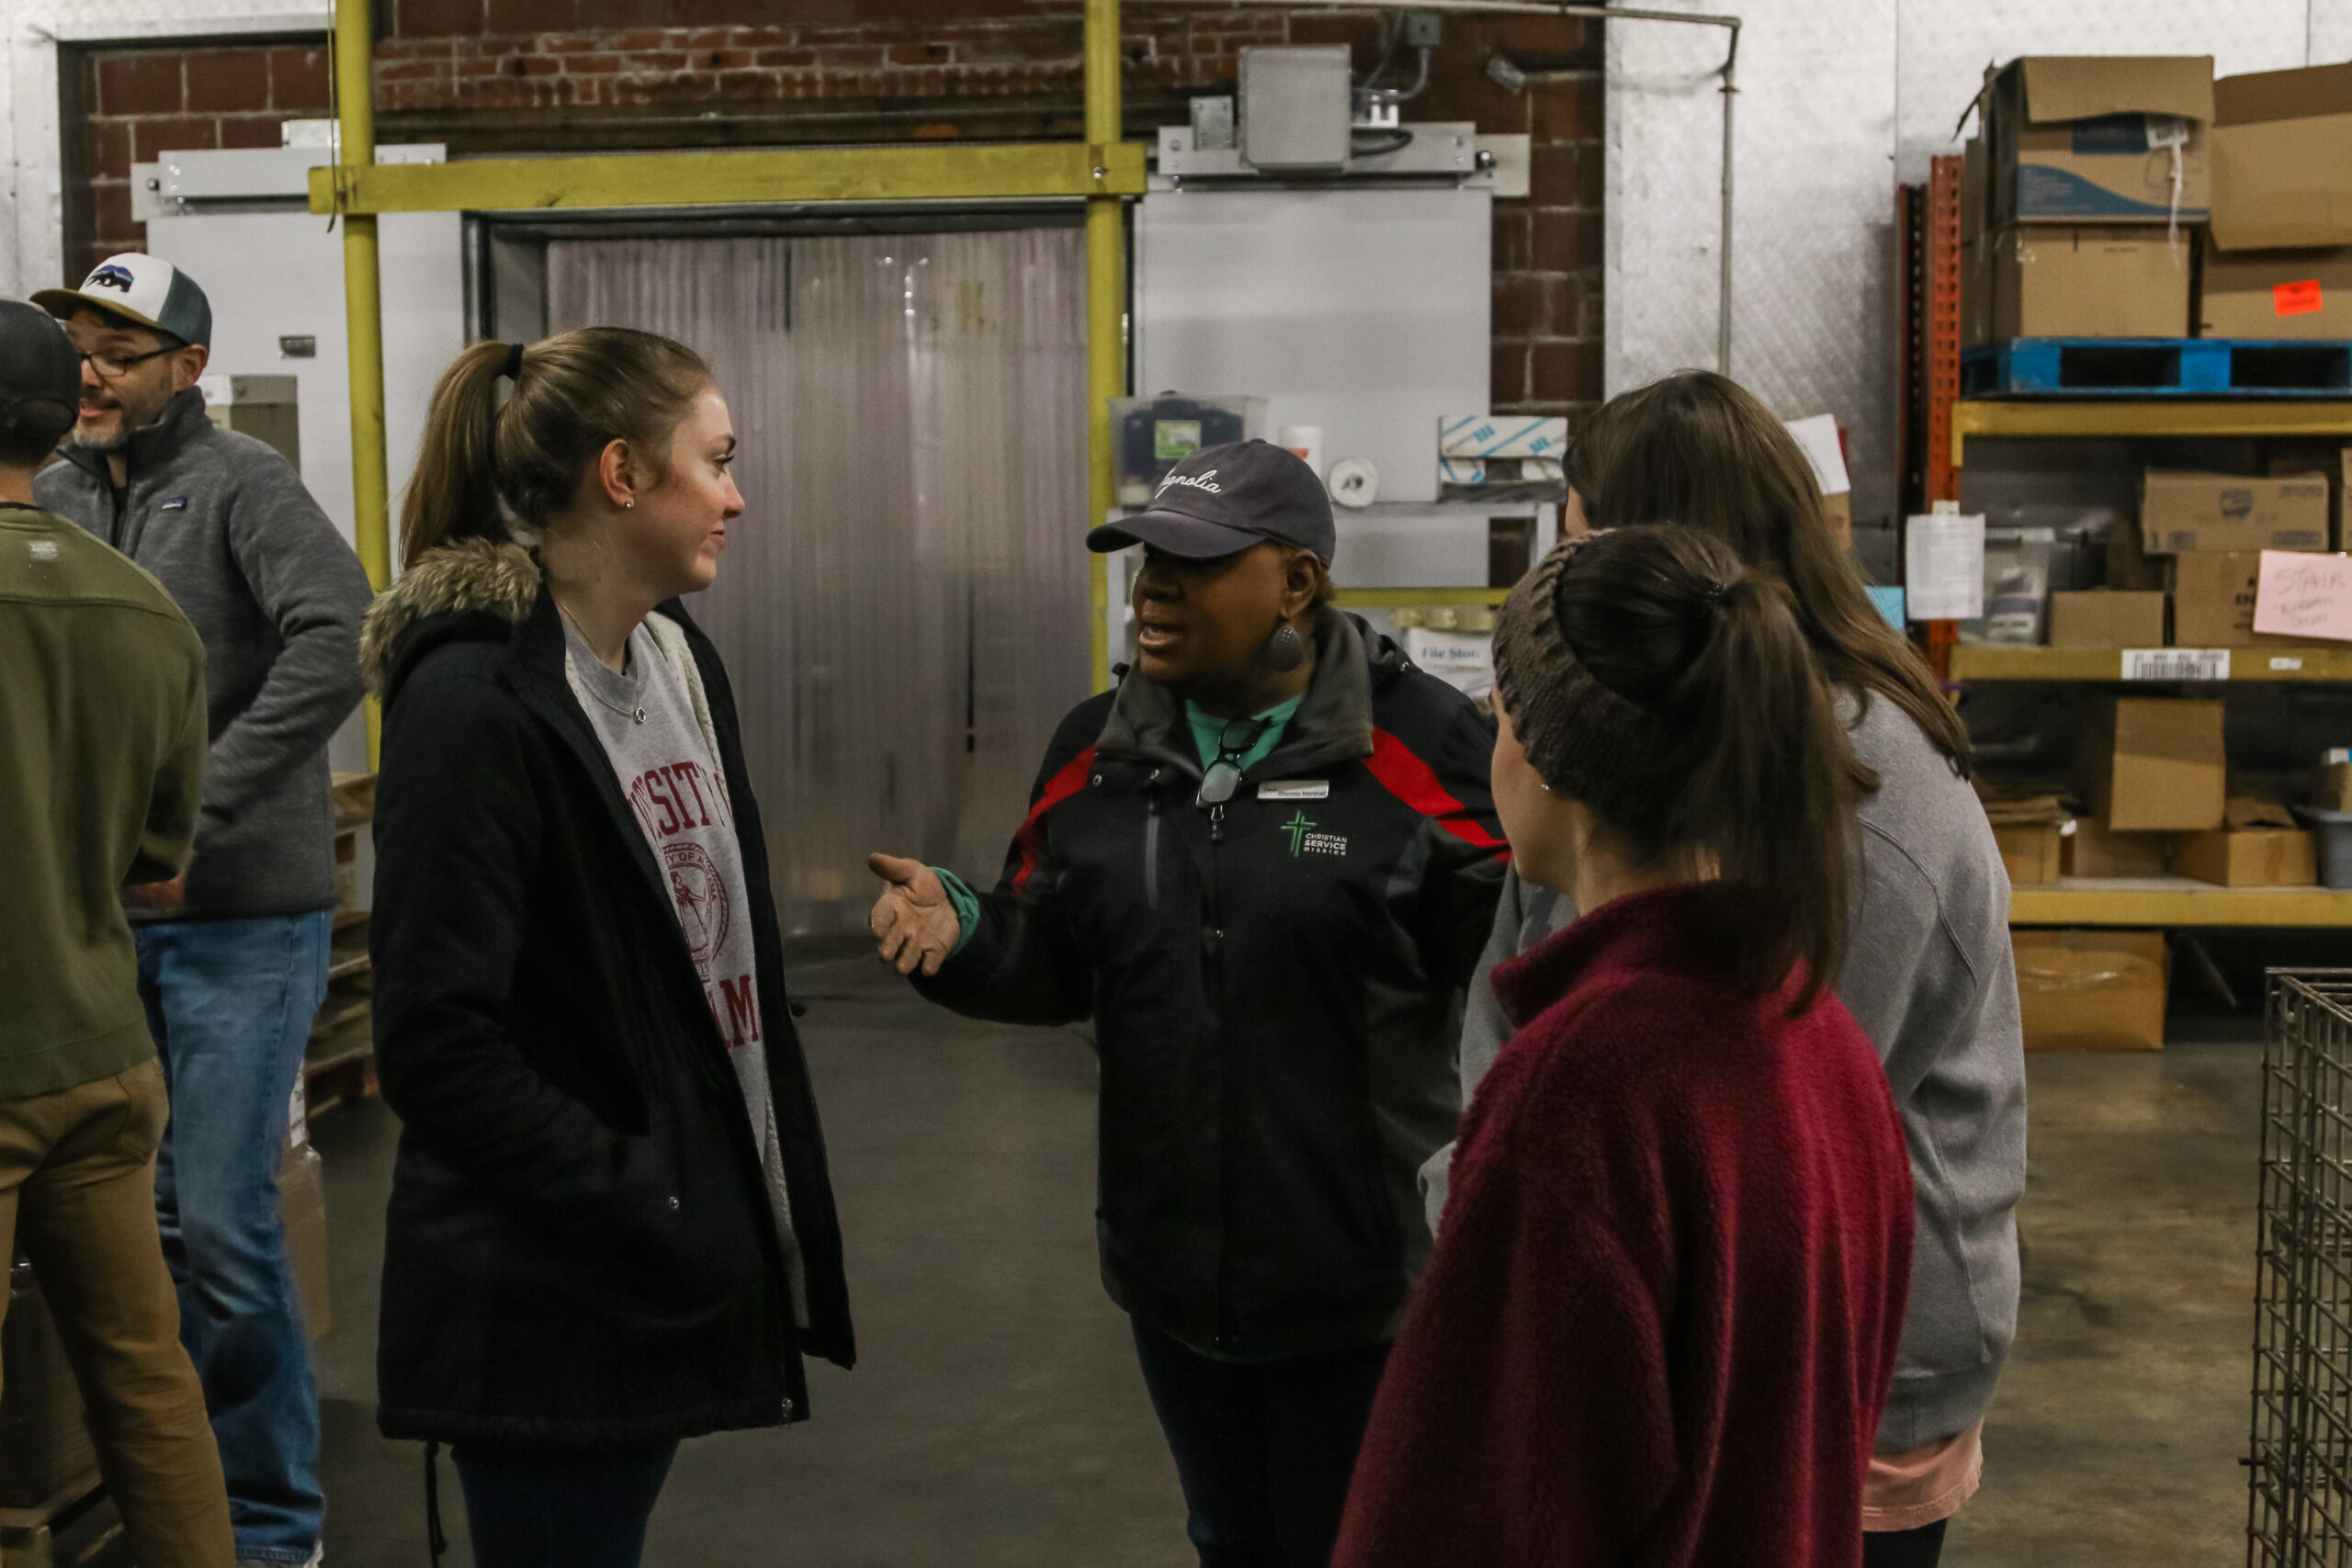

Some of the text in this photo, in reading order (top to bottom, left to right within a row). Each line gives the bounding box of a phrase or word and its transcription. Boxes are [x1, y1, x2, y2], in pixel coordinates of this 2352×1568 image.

[1155, 467, 1222, 499] agnolia
[1306, 832, 1348, 843] CHRISTIAN
[1304, 840, 1347, 851] SERVICE
[678, 852, 695, 862] OF
